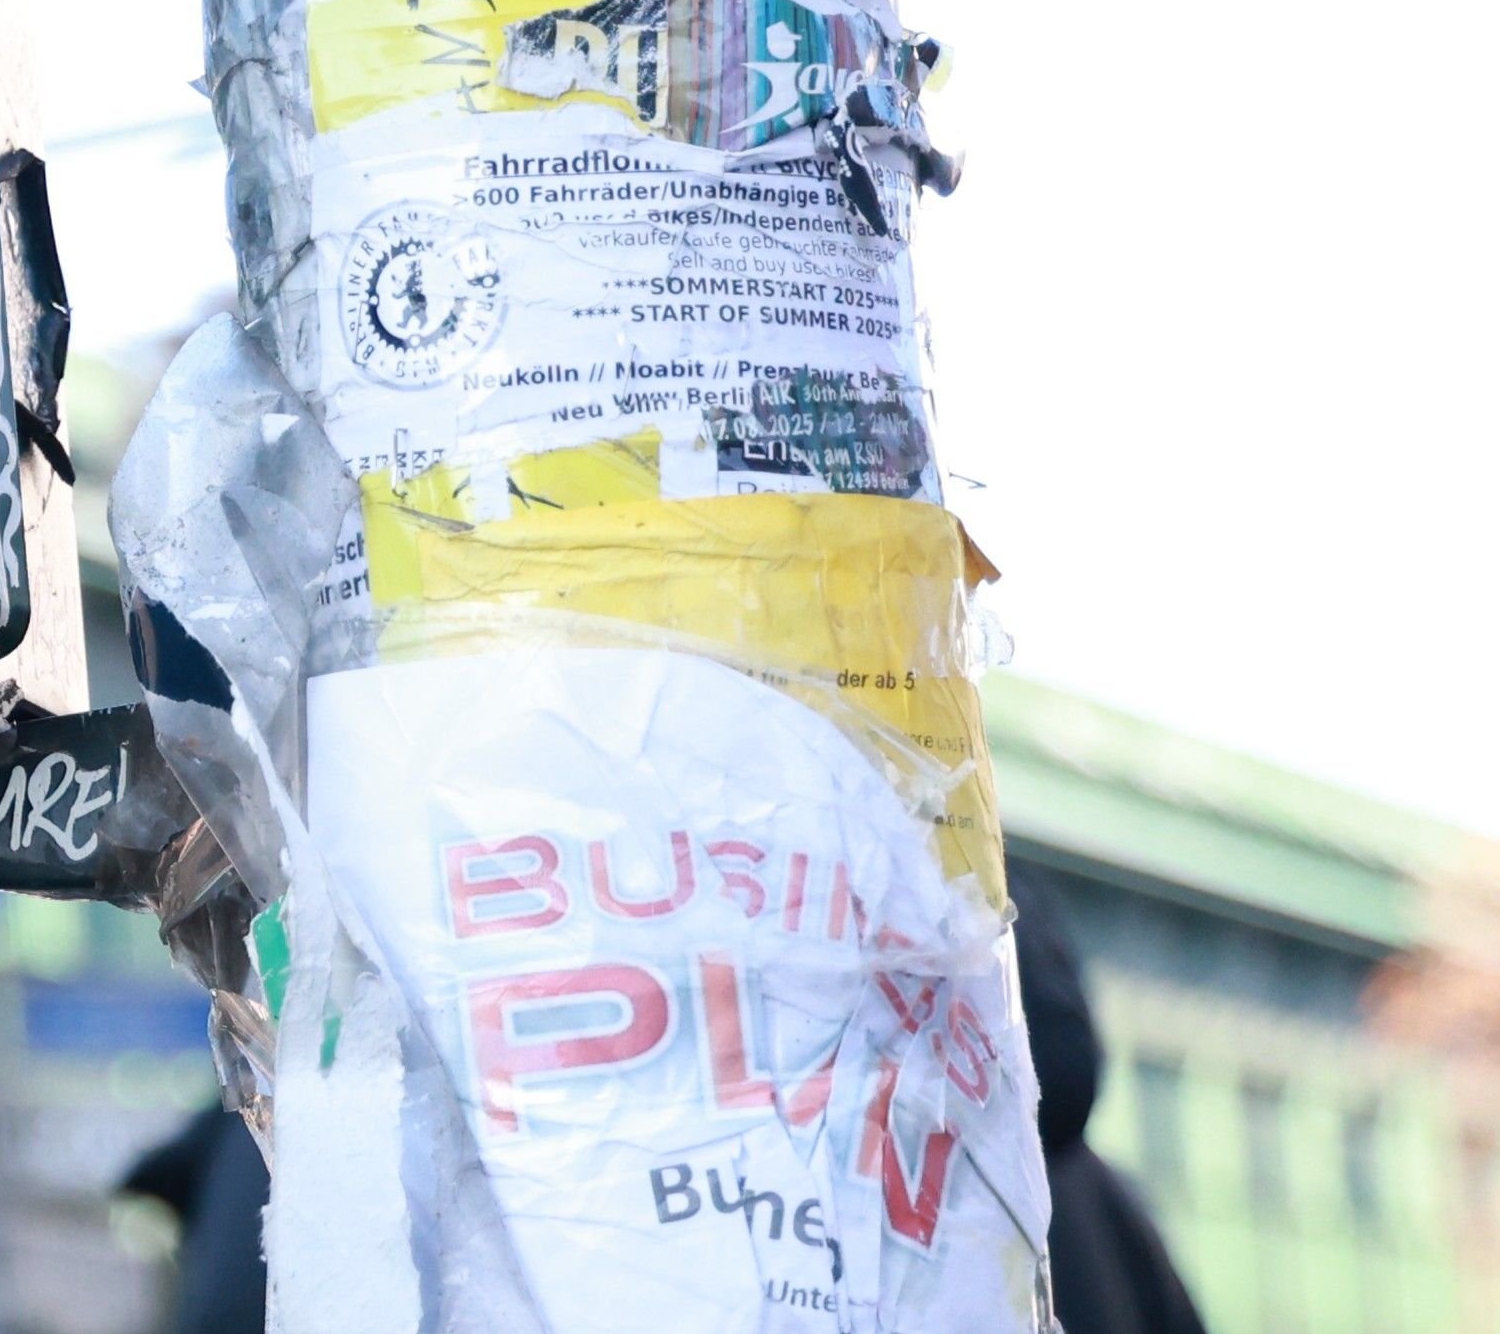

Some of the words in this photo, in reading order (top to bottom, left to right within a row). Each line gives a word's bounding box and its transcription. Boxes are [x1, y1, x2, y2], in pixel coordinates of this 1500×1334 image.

[630, 304, 711, 324] START
[718, 304, 752, 324] OF
[758, 305, 852, 334] SUMMER
[875, 668, 897, 690] ab
[903, 670, 916, 691] 5
